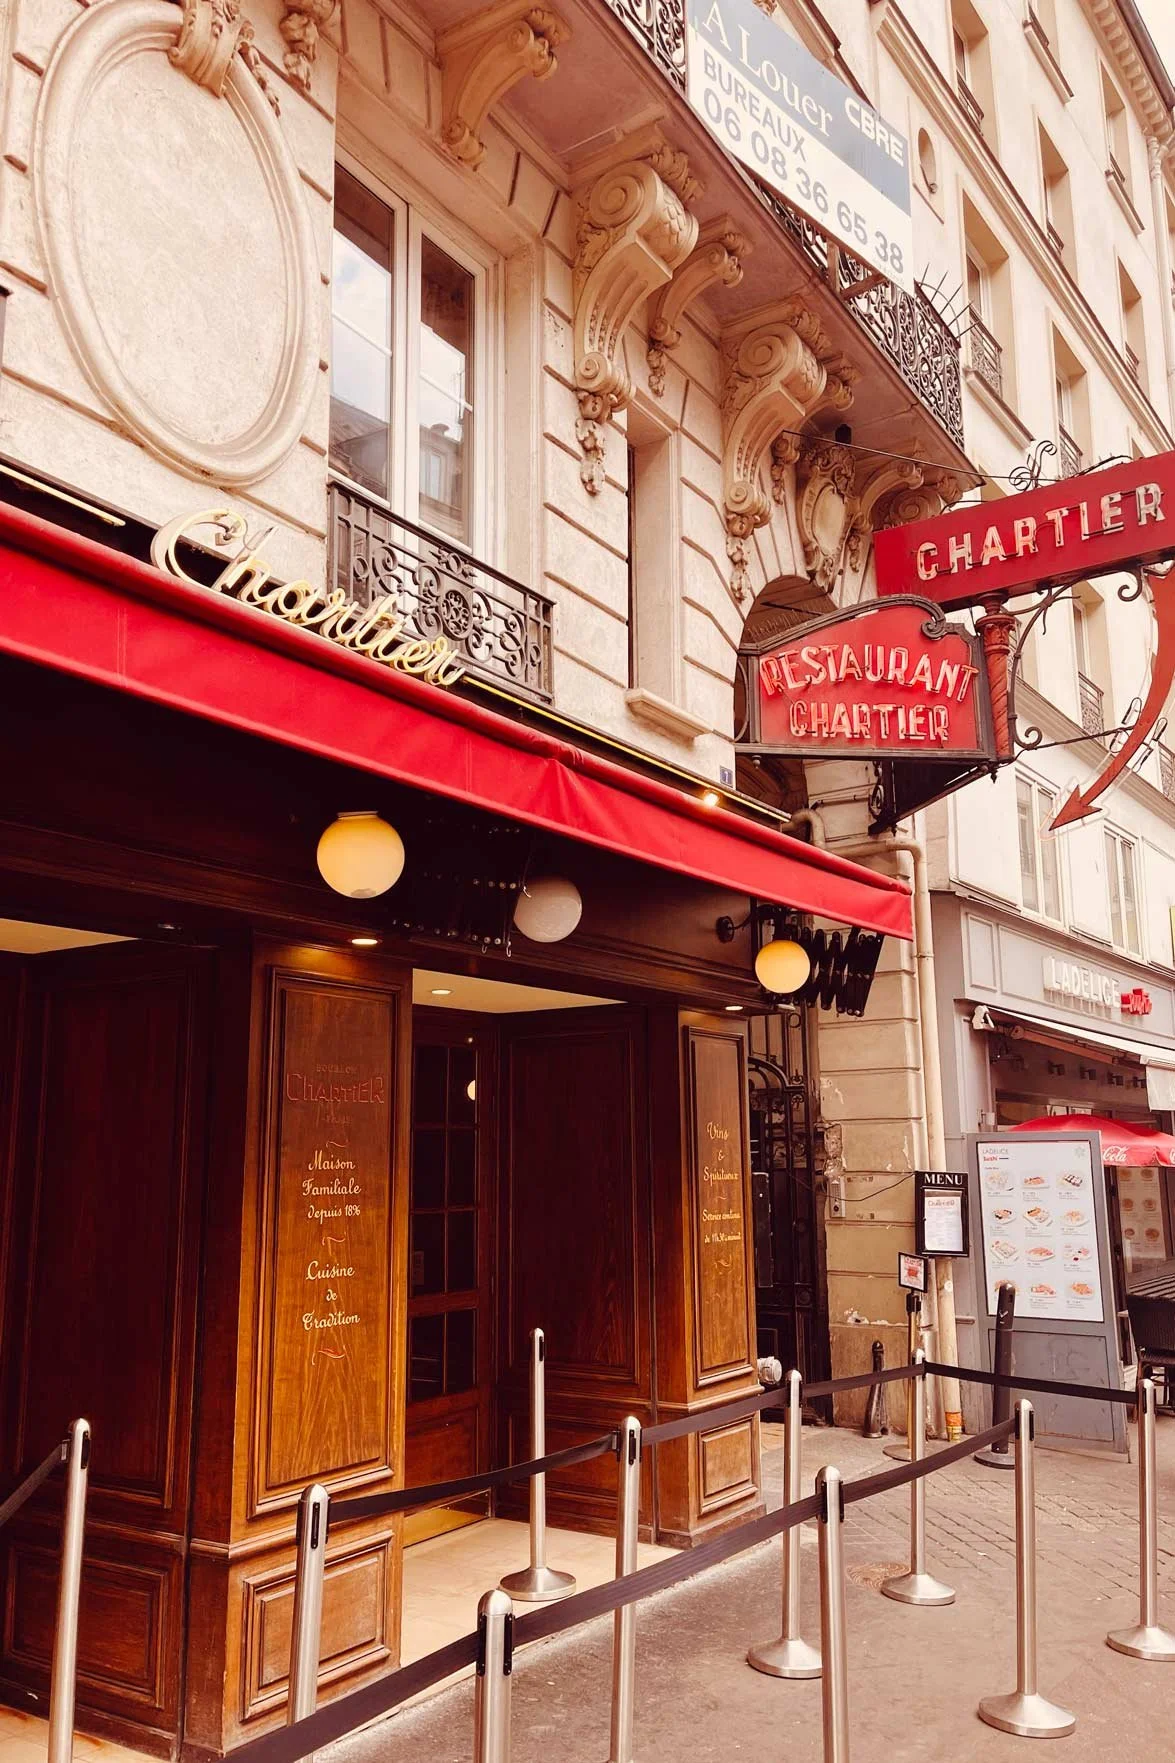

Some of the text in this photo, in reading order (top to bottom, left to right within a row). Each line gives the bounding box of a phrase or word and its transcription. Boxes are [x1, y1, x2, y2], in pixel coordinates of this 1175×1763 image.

[703, 1, 833, 137] A Louer
[703, 48, 808, 163] BUREAUX
[844, 97, 905, 167] CBRE
[703, 87, 742, 142] 06
[750, 130, 788, 181] 08
[796, 167, 829, 215] 36
[836, 200, 868, 246] 65
[875, 230, 904, 274] 38
[916, 482, 1167, 581] CHARTIER
[151, 508, 466, 687] Chartier
[760, 643, 979, 702] RESTAURANT
[789, 700, 950, 742] CHARTIER
[706, 1122, 729, 1140] Vins
[308, 1150, 356, 1171] Maison
[1103, 1146, 1128, 1162] Cola
[302, 1178, 362, 1196] Familiale
[924, 1173, 963, 1185] MENU
[307, 1205, 342, 1225] depuis
[305, 1261, 355, 1280] Cuisine
[326, 1288, 337, 1301] de
[302, 1313, 361, 1331] Tradition
